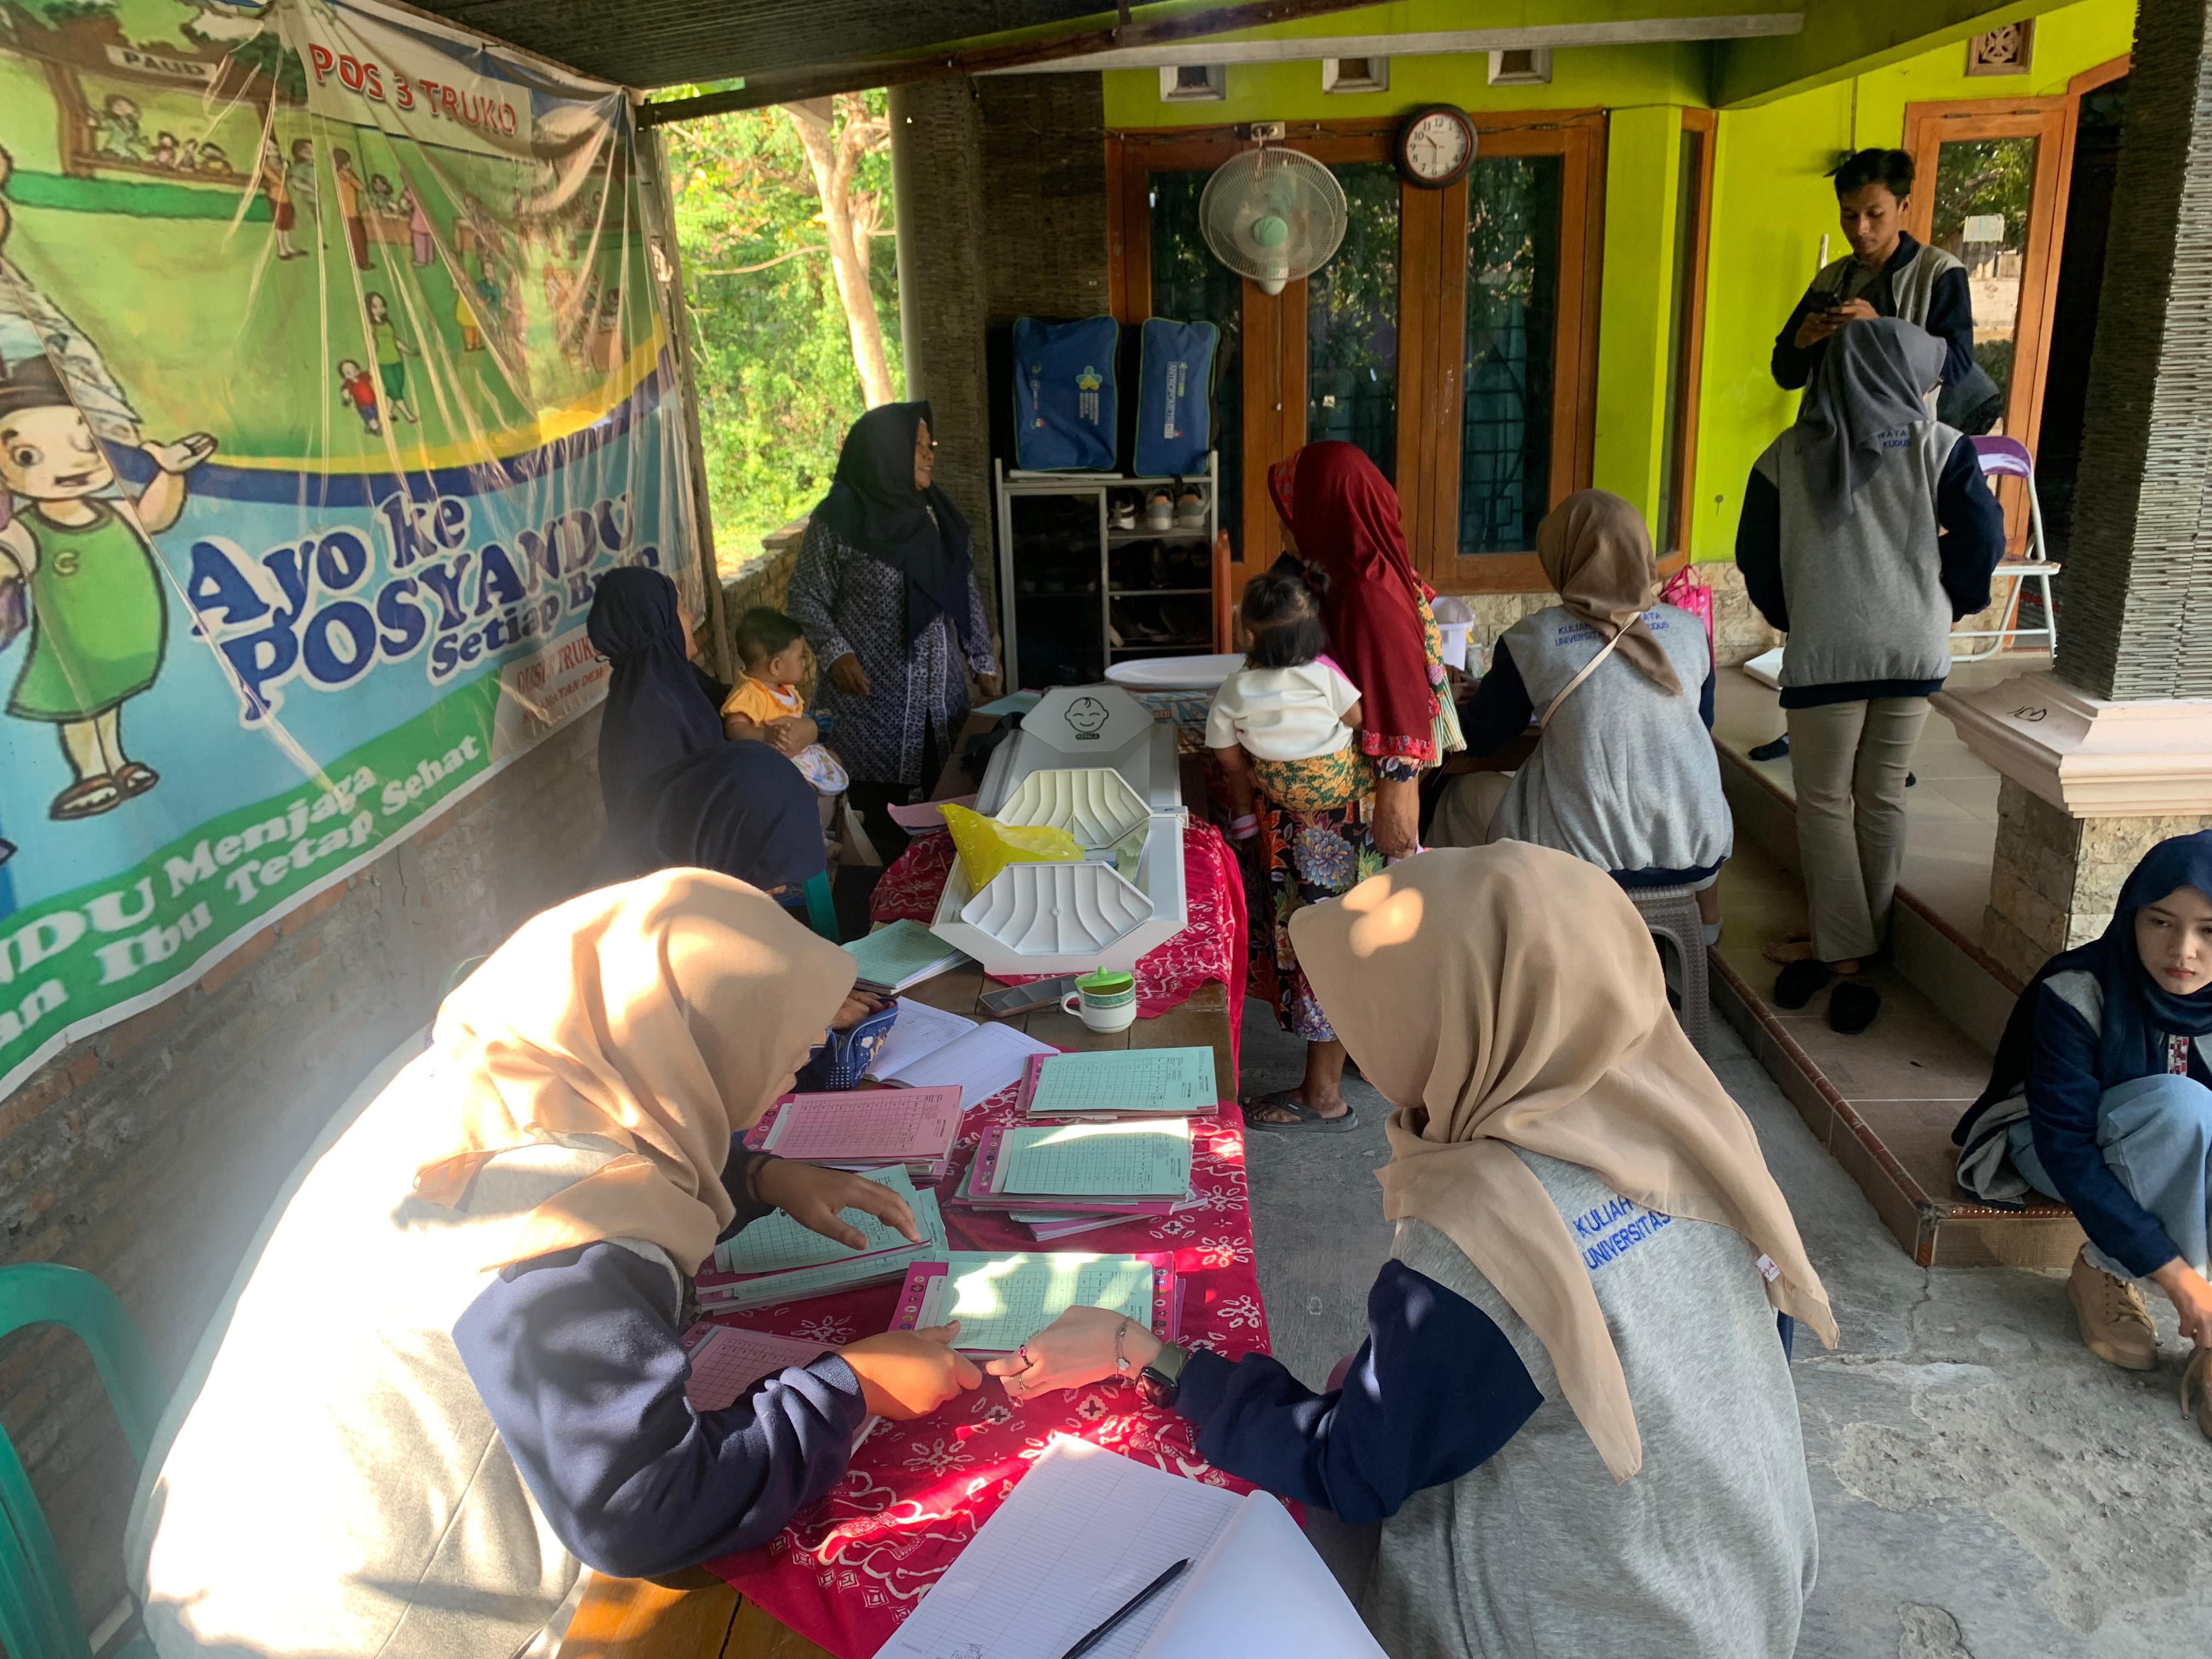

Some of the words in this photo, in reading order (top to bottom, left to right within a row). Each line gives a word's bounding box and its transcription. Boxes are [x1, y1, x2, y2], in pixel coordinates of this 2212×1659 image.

[123, 51, 206, 75] PAUD
[308, 43, 384, 100] POS
[394, 72, 413, 107] 3
[418, 78, 517, 134] TRUKO
[1424, 122, 1431, 131] 11
[1434, 118, 1443, 127] 12
[1414, 132, 1424, 140] 10
[1410, 143, 1416, 151] 9
[1413, 154, 1418, 162] 8
[1453, 154, 1458, 162] 4
[1421, 163, 1426, 172] 7
[1431, 167, 1437, 176] 6
[188, 531, 368, 636] Ayo
[384, 495, 466, 568] ke
[219, 494, 634, 721] POSYANDU
[1647, 622, 1669, 630] UDUS
[432, 595, 559, 678] Setiap
[1555, 631, 1604, 646] UNIVERSITA
[163, 765, 377, 899] Menjaga
[93, 900, 212, 986] Ibu
[225, 809, 374, 905] Tetap
[381, 734, 481, 815] Sehat
[1573, 1196, 1634, 1239] KULIAH
[1582, 1210, 1674, 1271] UNIVERSITAS
